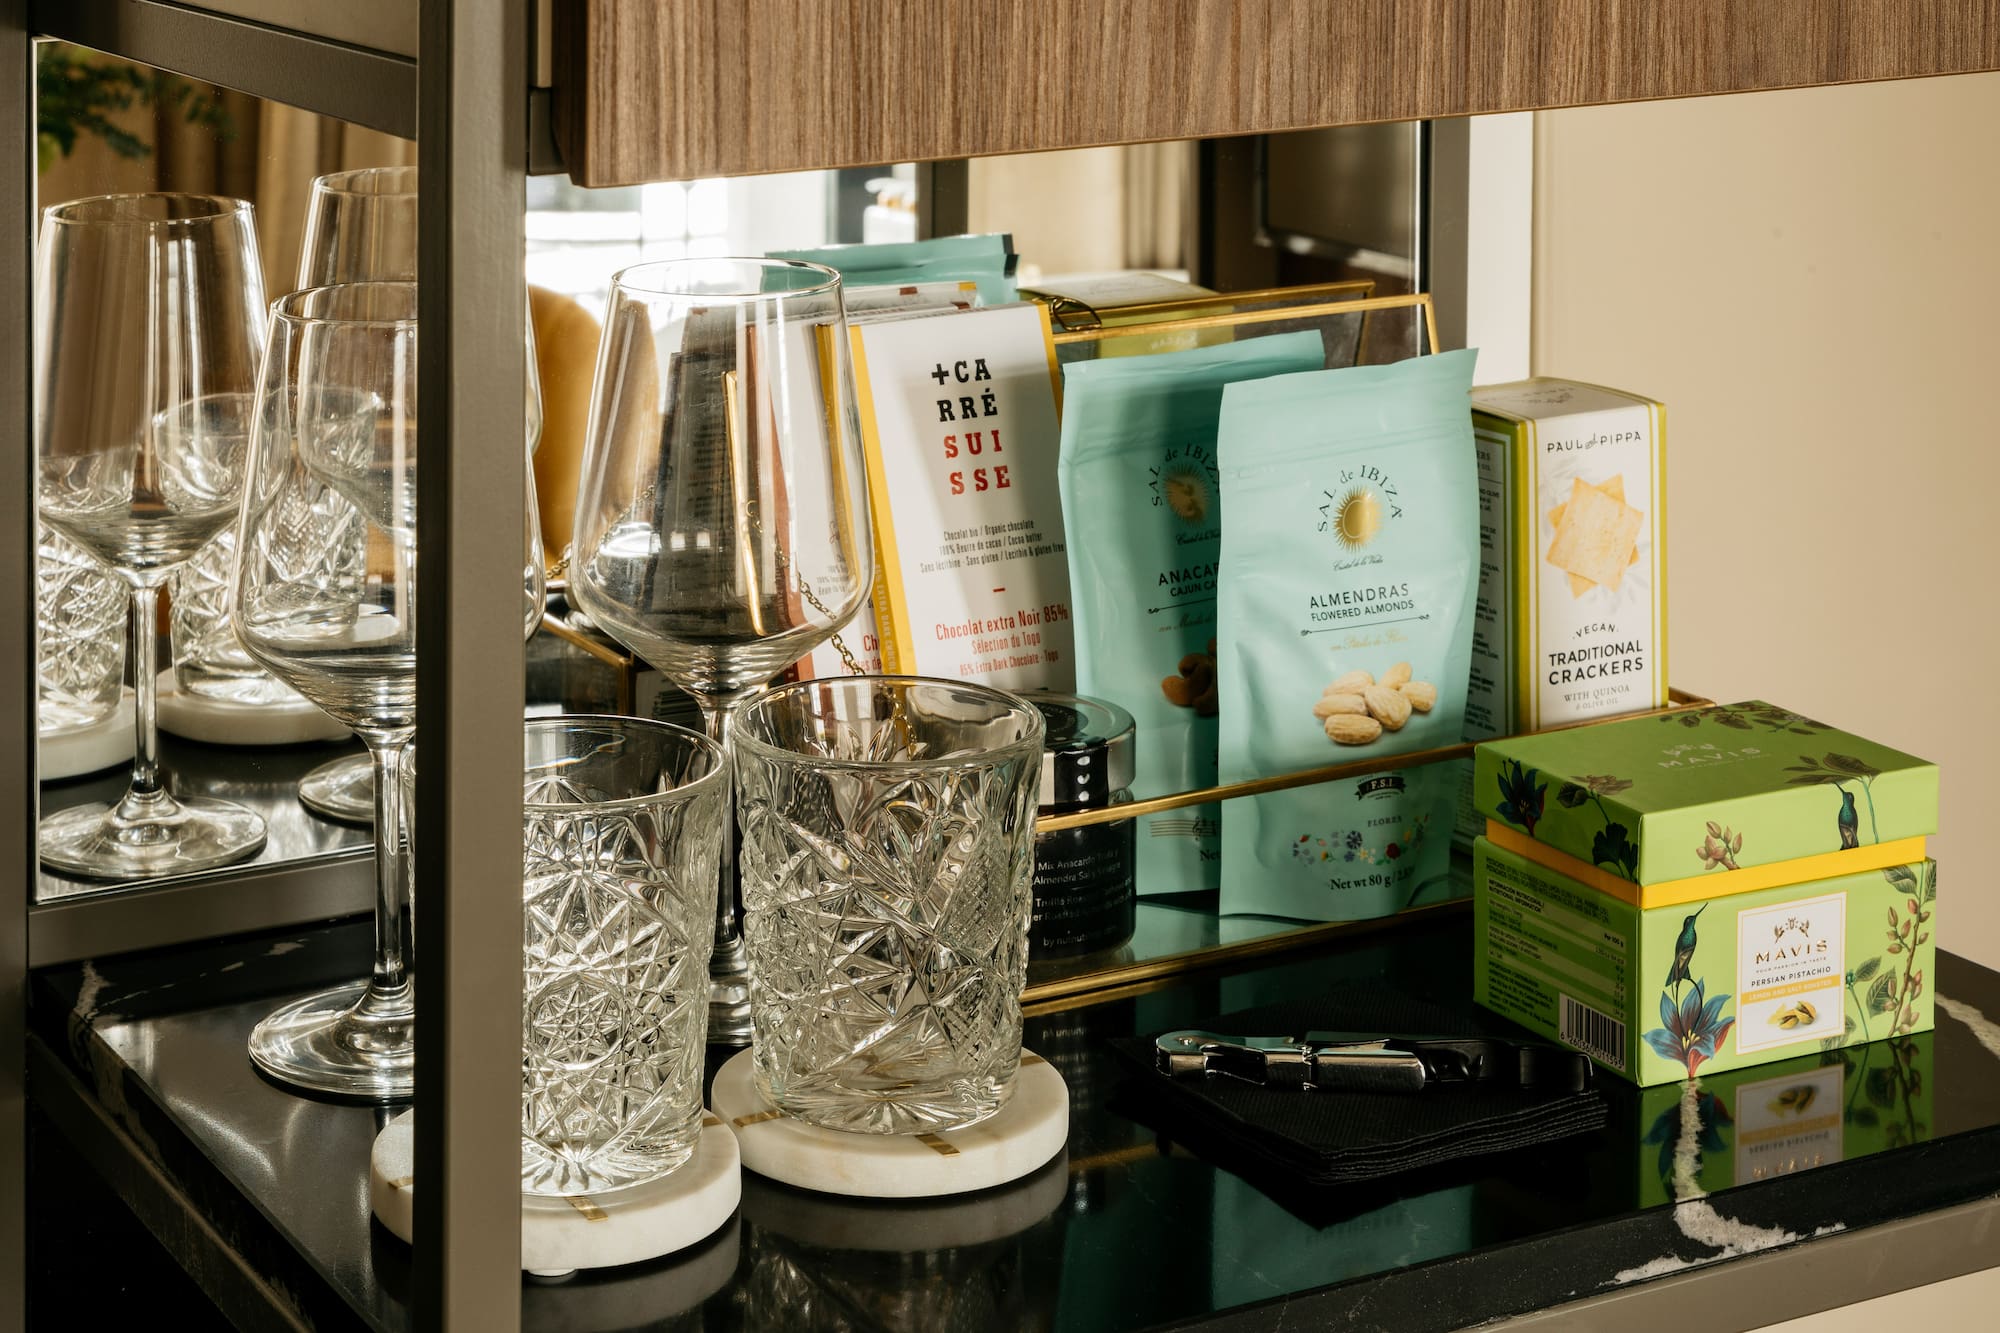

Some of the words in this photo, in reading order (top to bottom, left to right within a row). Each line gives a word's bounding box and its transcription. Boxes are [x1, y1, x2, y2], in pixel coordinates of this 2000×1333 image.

[936, 388, 998, 422] RRÉ
[944, 430, 1002, 458] SUI
[1547, 438, 1583, 454] PAUL
[1600, 431, 1642, 446] PIPPA
[950, 465, 1010, 495] SSE
[1148, 466, 1162, 506] SAL
[1165, 448, 1178, 462] de
[1318, 489, 1336, 532] SAL
[1340, 470, 1354, 484] de
[1360, 464, 1402, 518] IBIZA
[944, 528, 968, 542] Chocolat
[969, 526, 978, 537] bio
[984, 523, 1006, 536] Organic
[1008, 519, 1034, 532] chocolate
[956, 542, 976, 554] Beurre
[977, 540, 984, 550] de
[985, 539, 1002, 549] cacao
[1008, 535, 1024, 546] Cocoa
[1026, 532, 1043, 544] butter
[920, 562, 934, 573] Sans
[966, 555, 980, 566] Sans
[981, 552, 999, 564] gluten
[1005, 548, 1028, 560] Lecithin
[1035, 545, 1051, 557] gluten
[1053, 543, 1064, 553] free
[1170, 583, 1201, 597] CAJUN
[1310, 583, 1408, 608] ALMENDRAS
[936, 619, 984, 640] Chocolat
[987, 615, 1015, 632] extra
[1018, 608, 1041, 626] Noir
[1044, 603, 1068, 623] 85%
[1311, 607, 1361, 622] FLOWERED
[1364, 600, 1414, 615] ALMONDS
[1576, 623, 1615, 638] VEGAN
[972, 637, 1009, 655] Sélection
[1011, 633, 1021, 648] du
[1022, 631, 1041, 647] Togo
[1549, 640, 1643, 666] TRADITIONAL
[976, 660, 993, 674] Extra
[993, 658, 1008, 671] Dark
[1009, 652, 1040, 668] Chocolate
[1044, 650, 1059, 663] Togo
[1549, 658, 1643, 686] CRACKERS
[1564, 692, 1589, 702] WITH
[1593, 684, 1630, 699] QUINOA
[1582, 701, 1604, 709] OLIVE
[1658, 747, 1760, 768] MAVIS
[1368, 815, 1402, 827] FLORES
[1034, 873, 1077, 885] Almendra
[1330, 877, 1350, 890] Net
[1354, 878, 1367, 887] wt
[1369, 874, 1382, 886] 80
[1043, 937, 1054, 948] by
[1756, 940, 1827, 965] MAVIS
[1752, 976, 1785, 987] PERSIAN
[1789, 966, 1831, 980] PISTACHIO
[1560, 1032, 1565, 1040] 6
